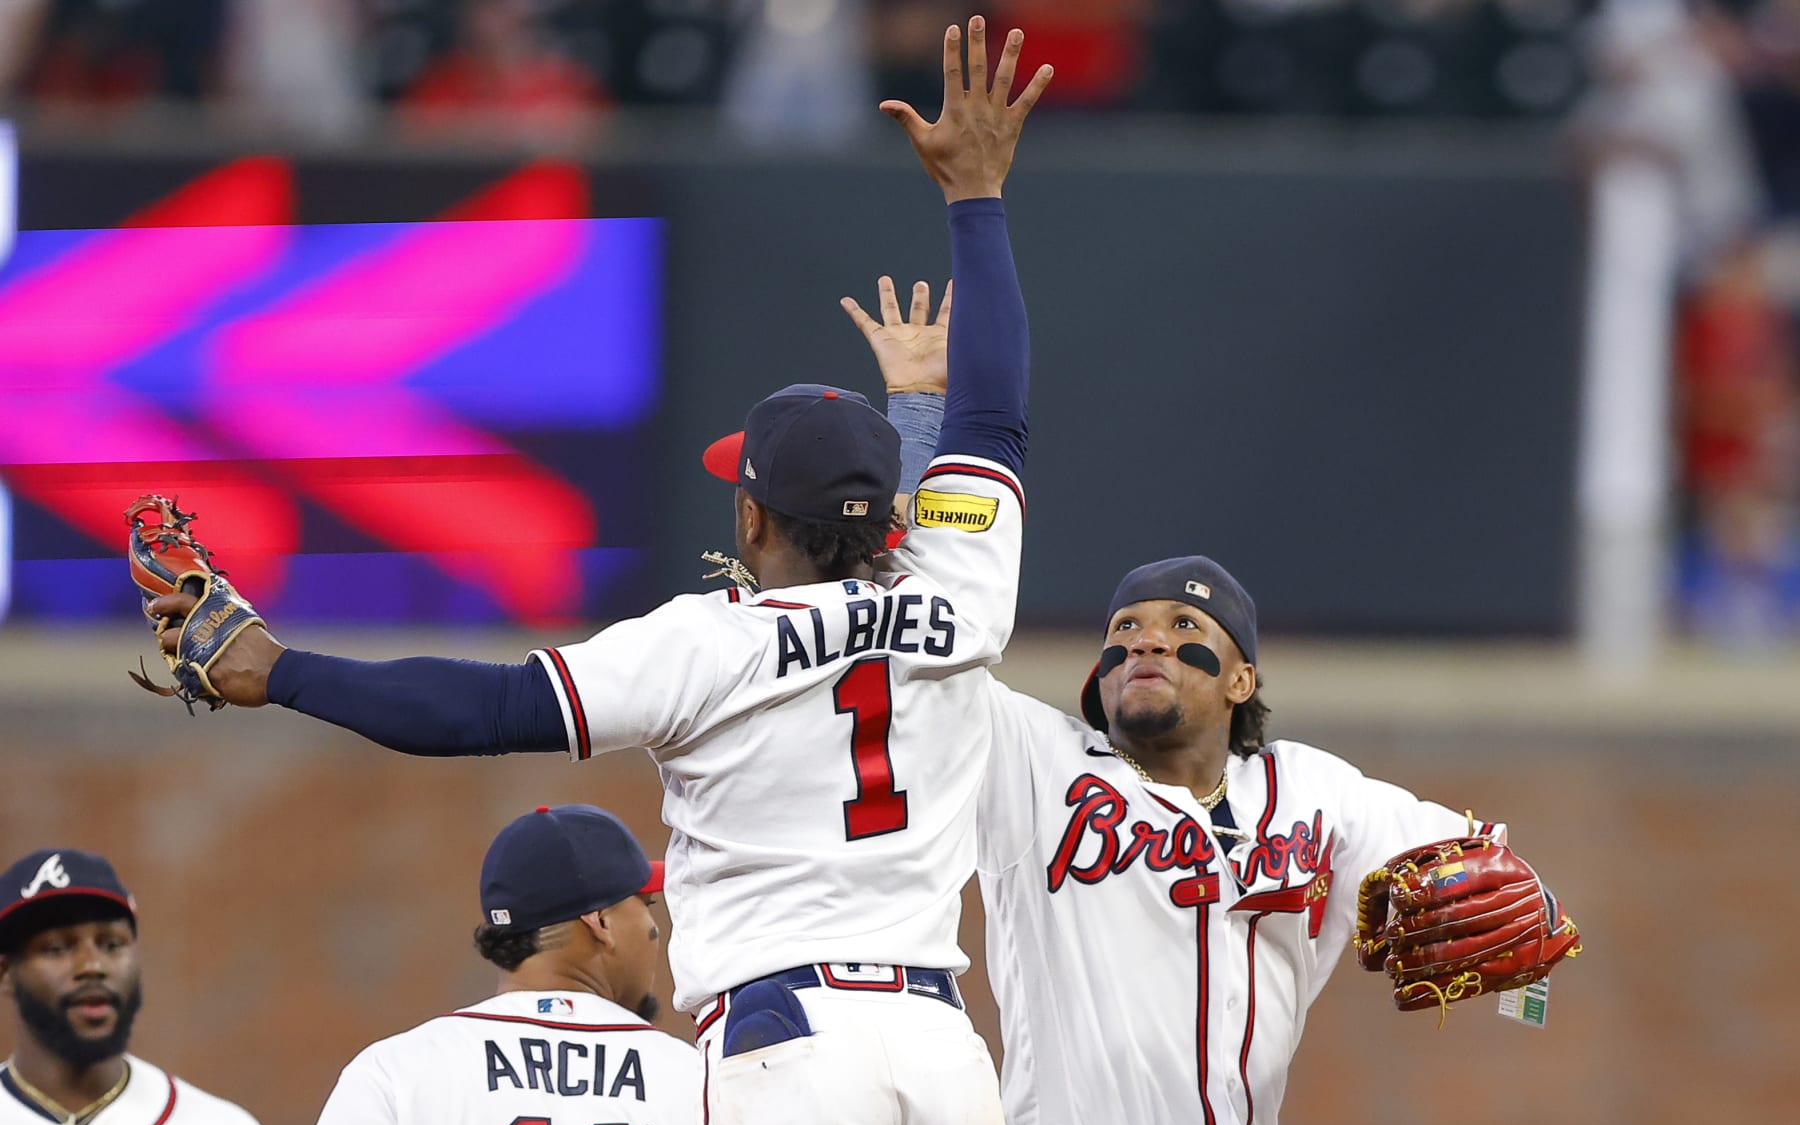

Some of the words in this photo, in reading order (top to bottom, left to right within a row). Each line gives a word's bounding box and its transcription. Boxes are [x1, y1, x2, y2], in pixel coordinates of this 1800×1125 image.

[921, 507, 988, 526] QUIKRETE
[191, 602, 238, 644] Wilson
[776, 594, 956, 678] ALBIES
[832, 656, 909, 842] 1
[484, 1036, 647, 1103] ARCIA
